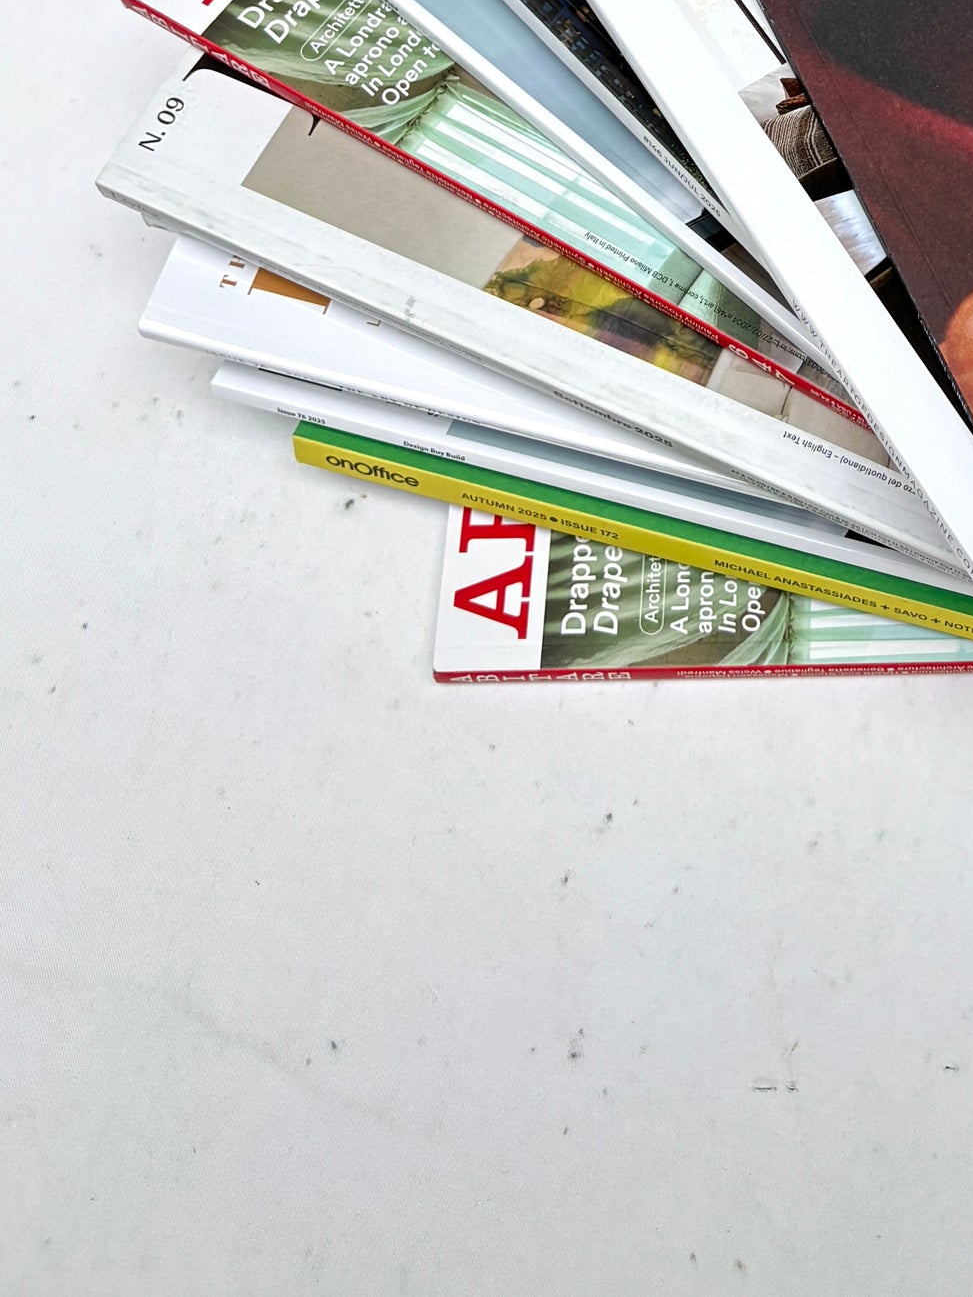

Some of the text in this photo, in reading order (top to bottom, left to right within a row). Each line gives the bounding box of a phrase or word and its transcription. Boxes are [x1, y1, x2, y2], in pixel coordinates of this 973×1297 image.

[128, 2, 275, 88] ABITARE
[324, 58, 345, 76] A
[336, 2, 394, 59] Londra
[345, 26, 401, 86] aprono
[361, 76, 384, 97] In
[377, 30, 423, 78] Lond
[381, 58, 428, 106] Open
[138, 97, 185, 152] N. 09
[698, 192, 723, 216] 2025
[583, 230, 600, 244] Italy
[604, 243, 630, 261] Printed
[628, 256, 652, 274] Milano
[651, 269, 668, 283] DCB
[306, 415, 326, 424] 2025
[633, 425, 673, 448] 2025
[781, 430, 802, 445] Text
[801, 437, 833, 459] English
[402, 440, 465, 461] Design Buy Build
[323, 452, 420, 488] onOffice
[838, 454, 888, 484] quotidiano)
[887, 477, 902, 489] del
[461, 491, 619, 539] AUTUMN 2025 ISSUE 172
[593, 546, 628, 635] Drape
[713, 559, 771, 580] MICHAEL
[773, 575, 877, 607] ANASTASSIADES
[893, 606, 928, 621] SAVO
[717, 575, 738, 633] In Lo
[741, 582, 765, 632] Ope
[670, 616, 689, 634] A
[449, 668, 631, 685] ABITARE
